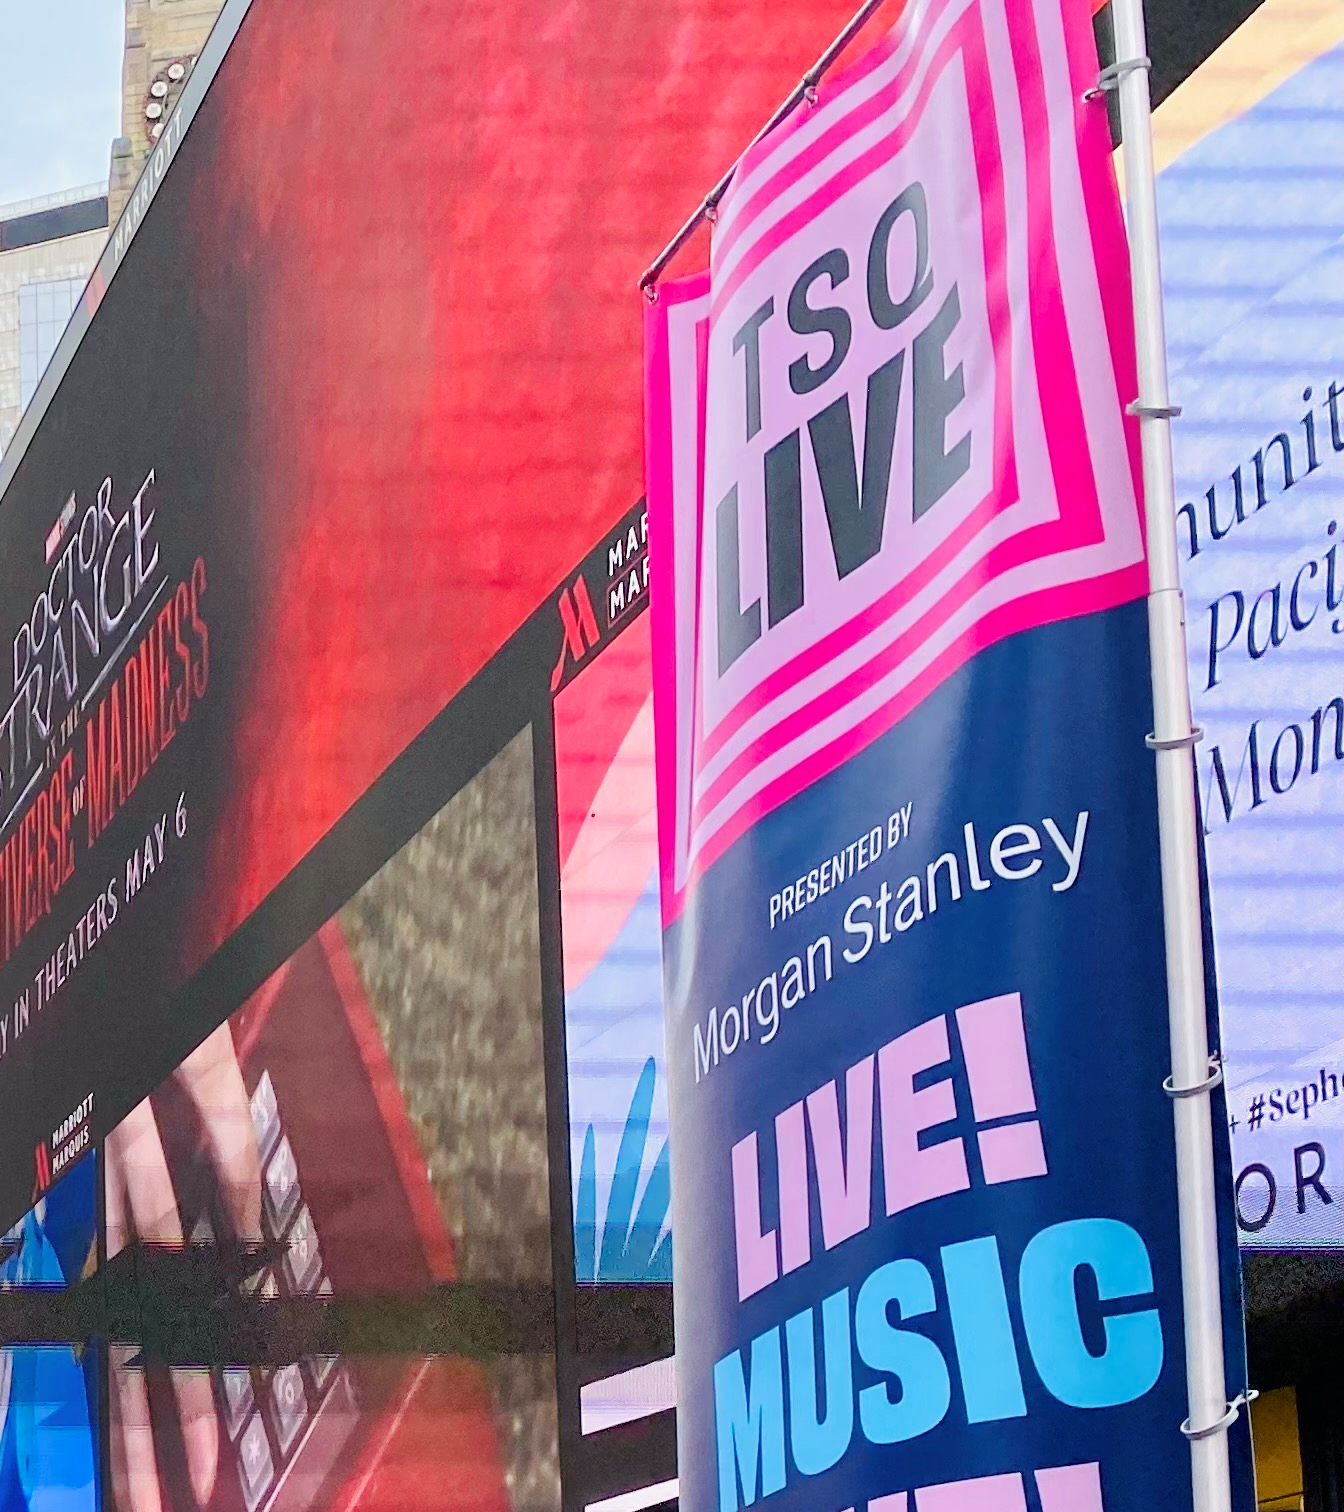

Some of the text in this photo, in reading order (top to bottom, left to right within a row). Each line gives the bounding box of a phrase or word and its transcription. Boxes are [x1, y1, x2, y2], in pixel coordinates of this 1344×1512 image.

[732, 180, 937, 444] TSQ
[13, 475, 115, 692] DOCTOR
[716, 279, 973, 679] LIVE
[86, 555, 209, 850] MADNESS
[1205, 520, 1344, 692] Paci
[61, 699, 80, 747] THE
[14, 989, 30, 1041] IN
[37, 877, 118, 1015] THEATERS
[125, 813, 168, 905] MAY
[175, 791, 188, 838] 6
[692, 811, 1090, 1085] Morgan Stanley
[768, 801, 914, 930] PRESENTED BY
[51, 1092, 95, 1149] MARRIOTT
[51, 1123, 90, 1175] MARQUIS
[731, 991, 1048, 1304] LIVE!
[1247, 1067, 1344, 1132] #Seph
